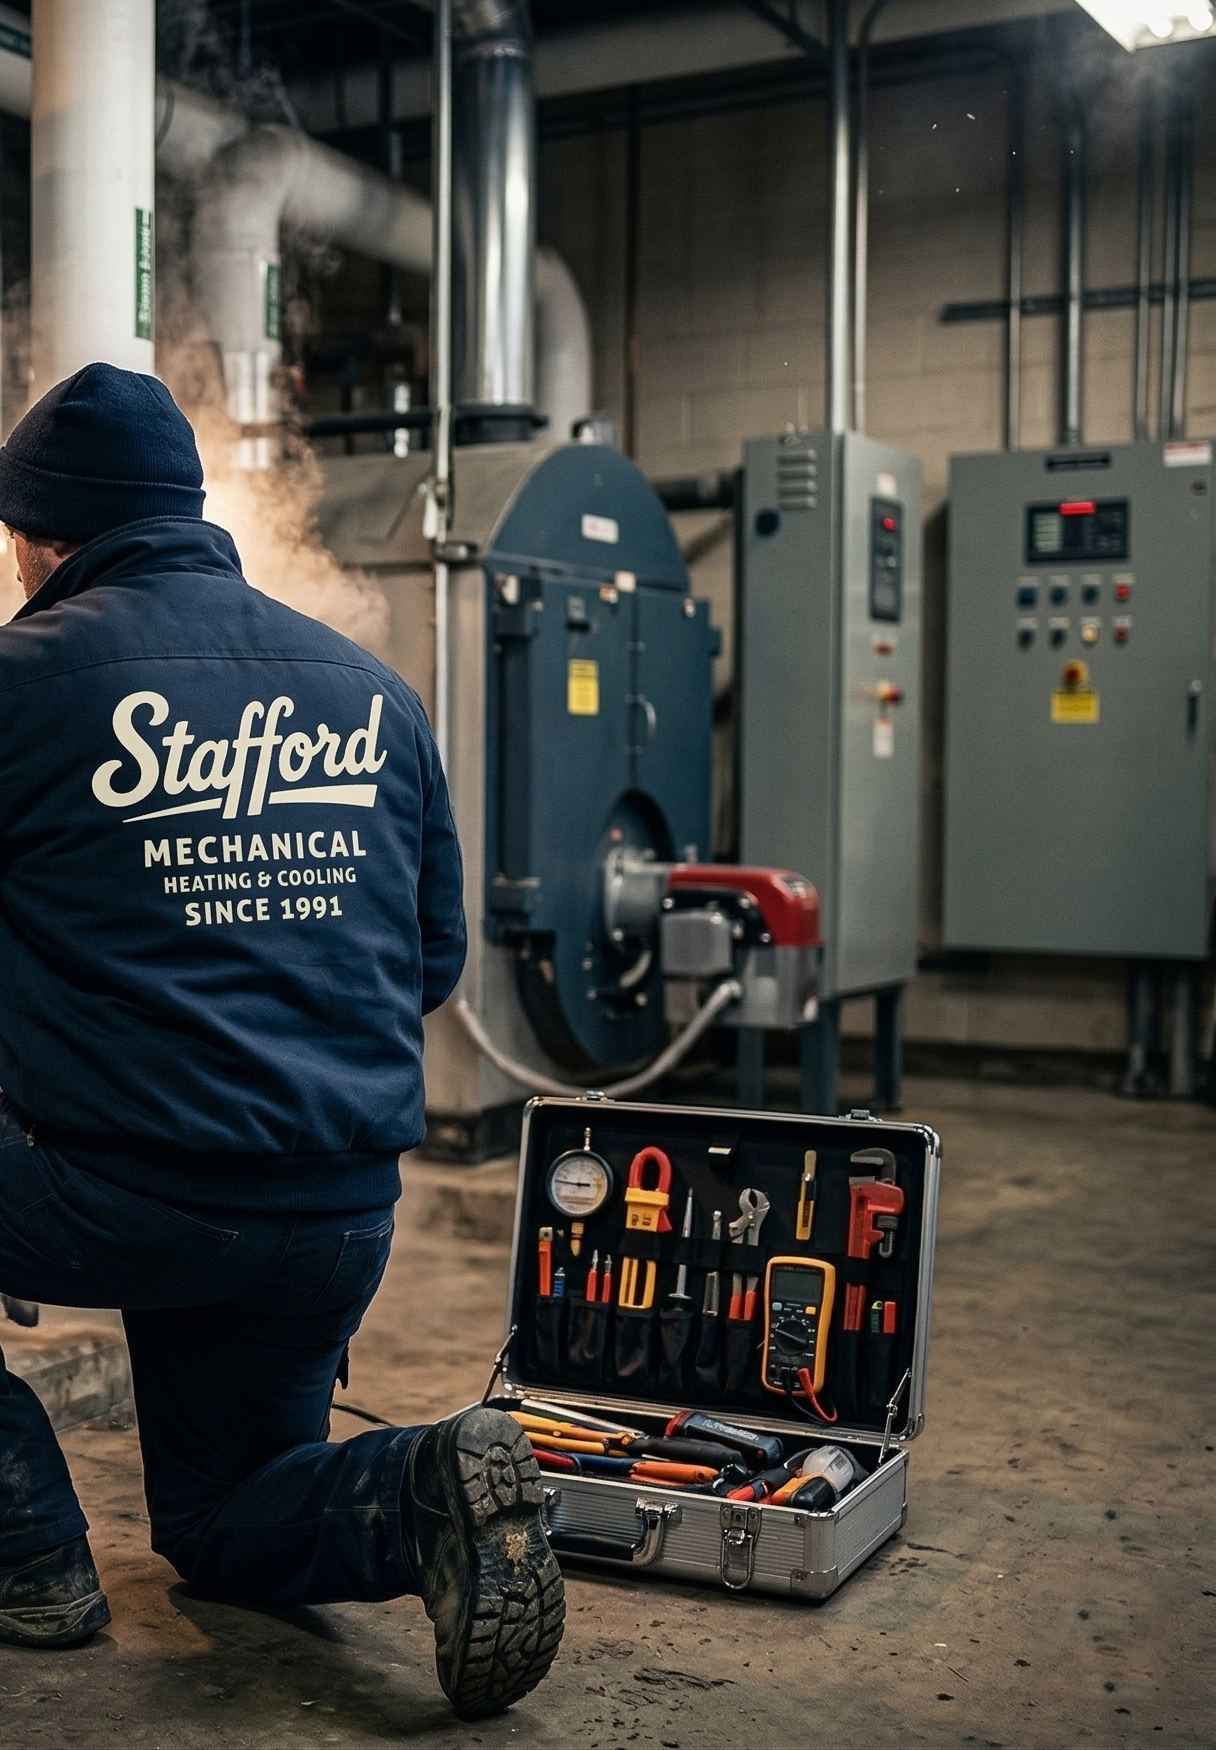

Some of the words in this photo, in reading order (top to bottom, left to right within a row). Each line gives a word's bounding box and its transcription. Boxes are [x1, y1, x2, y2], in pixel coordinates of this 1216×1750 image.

[91, 690, 388, 820] Stafford
[144, 830, 367, 868] MECHANICAL
[164, 871, 252, 894] HEATING
[257, 871, 272, 888] &
[277, 867, 357, 887] COOLING
[185, 897, 271, 926] SINCE
[280, 895, 343, 920] 1991
